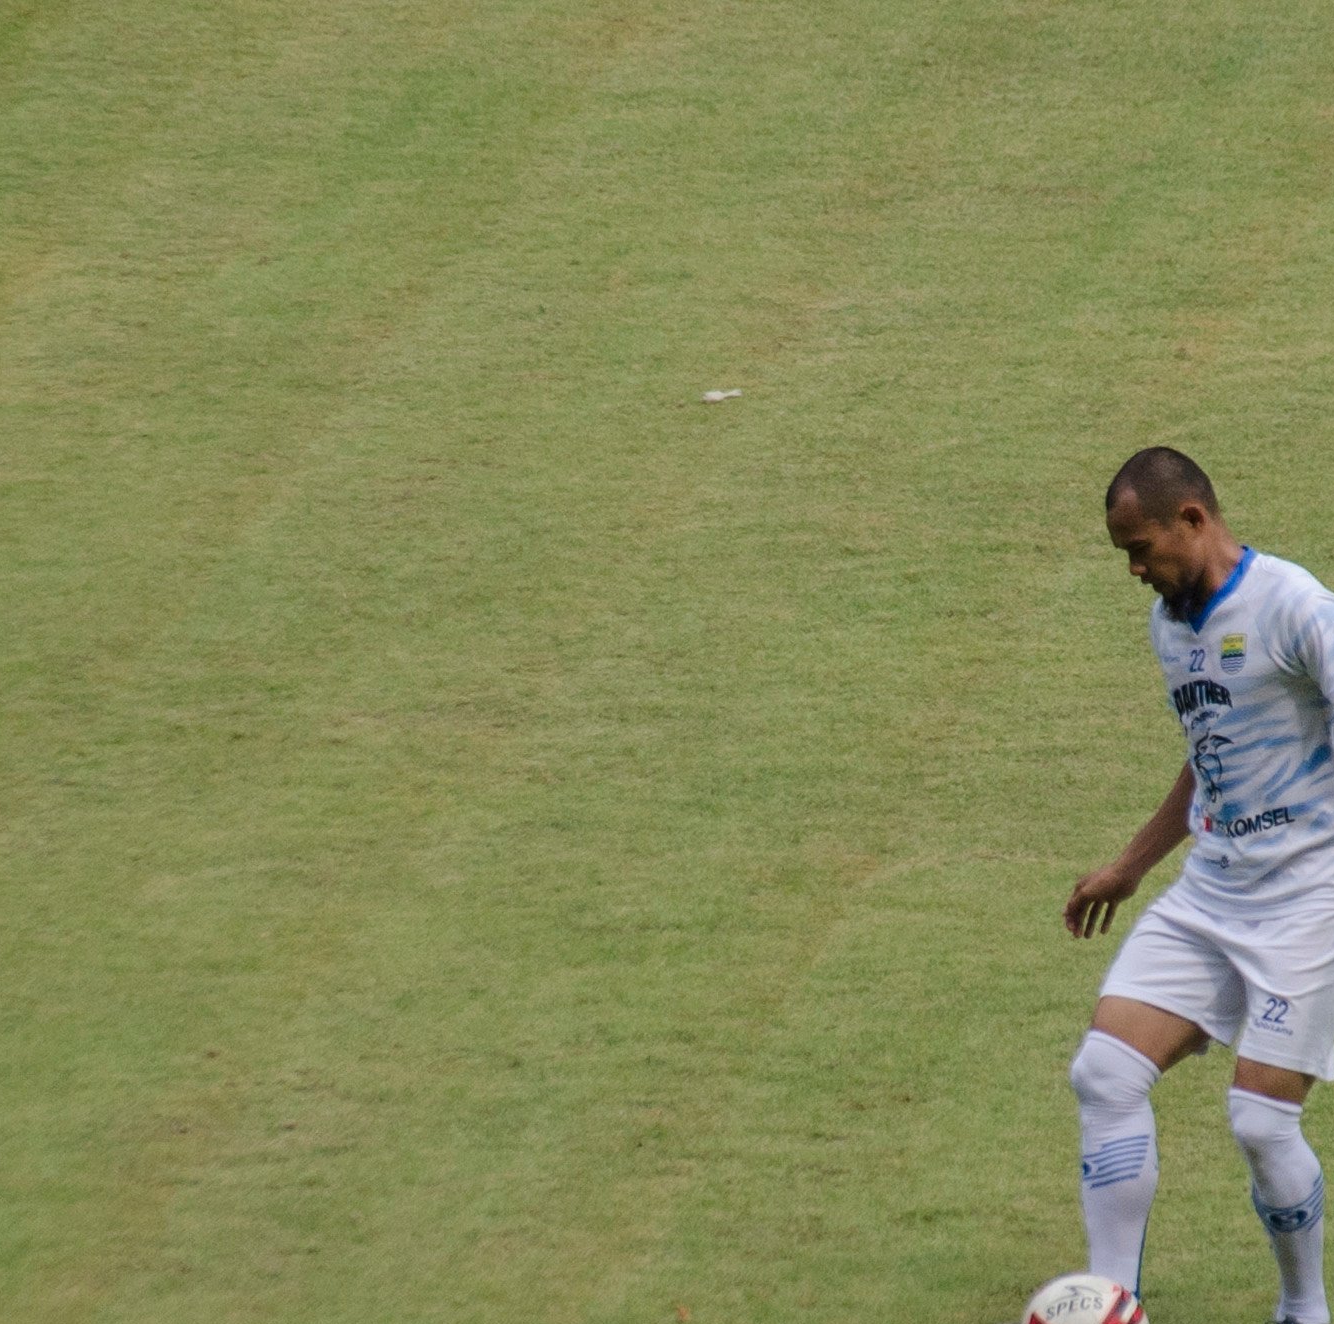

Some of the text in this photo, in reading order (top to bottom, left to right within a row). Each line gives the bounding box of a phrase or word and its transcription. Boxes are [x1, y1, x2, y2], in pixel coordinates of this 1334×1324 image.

[1190, 649, 1205, 672] 22
[1262, 997, 1288, 1024] 22
[1046, 1297, 1104, 1319] SPECS
